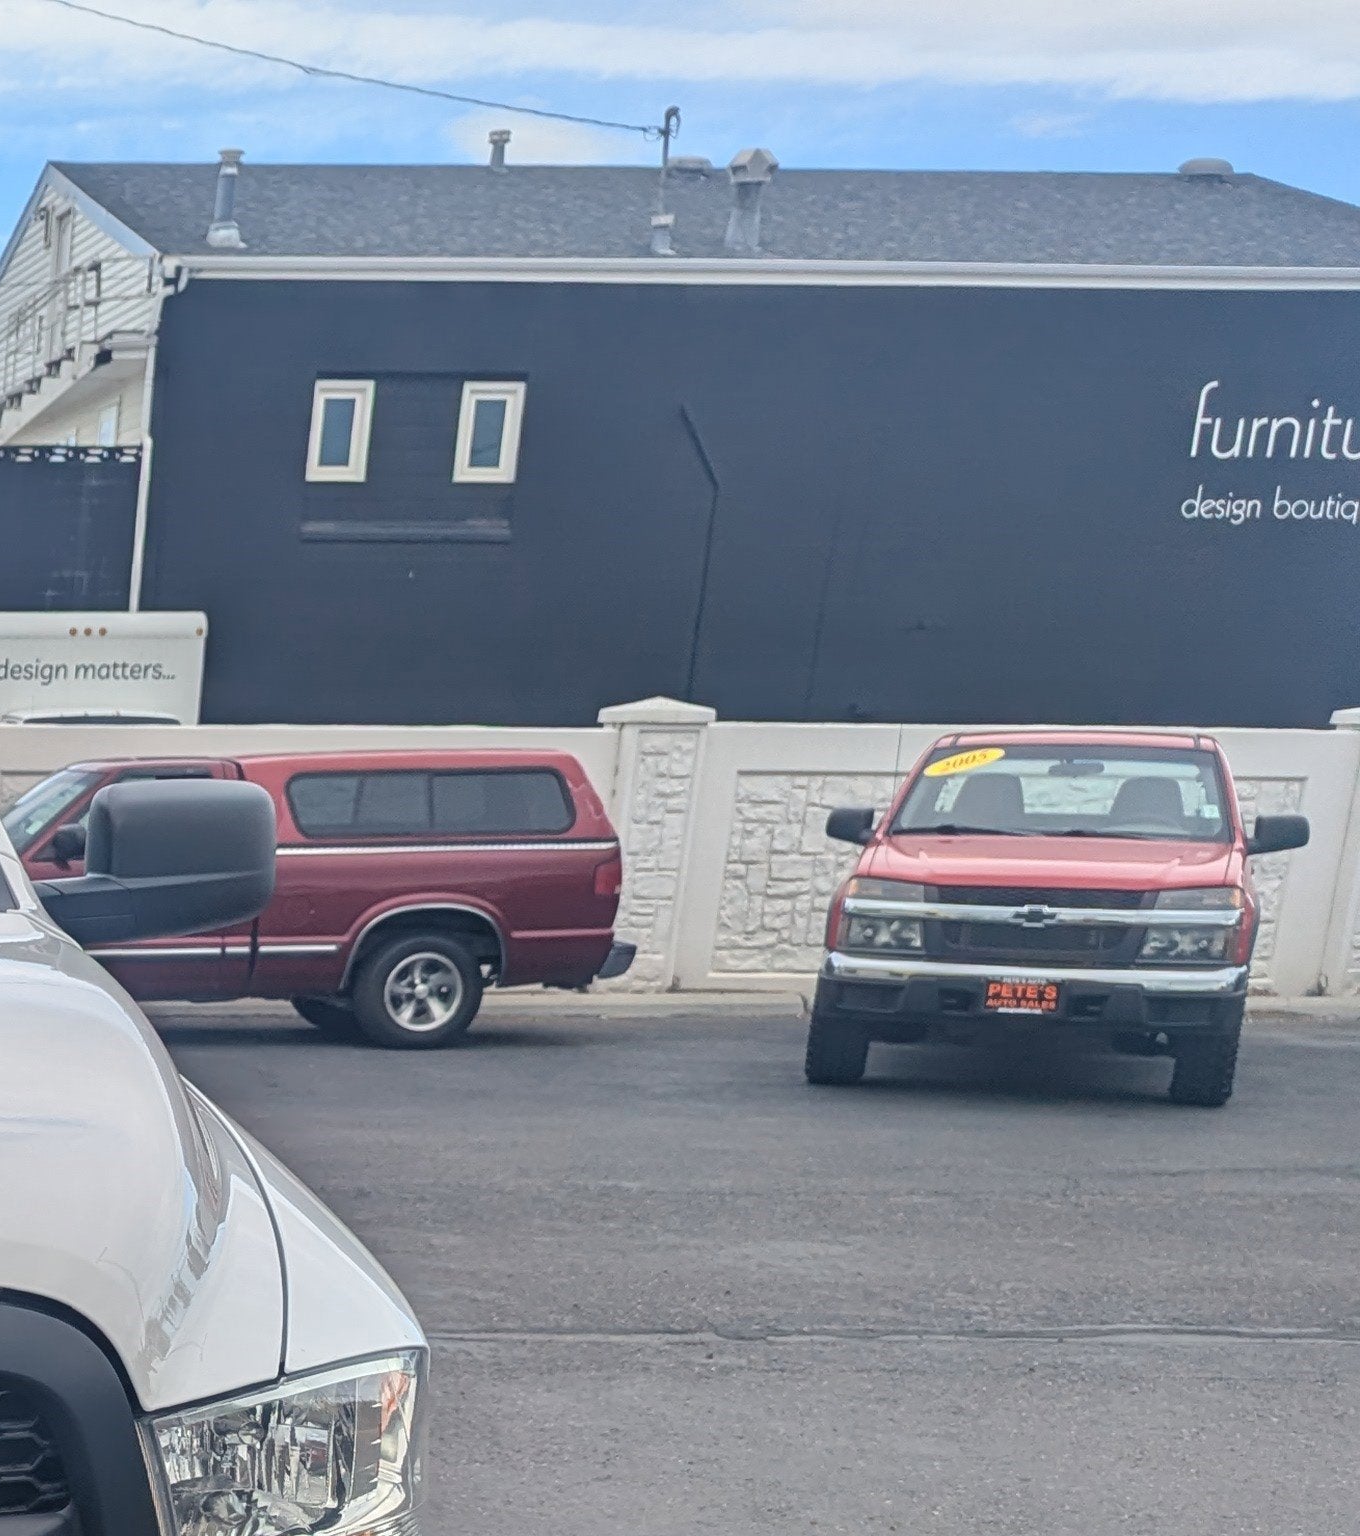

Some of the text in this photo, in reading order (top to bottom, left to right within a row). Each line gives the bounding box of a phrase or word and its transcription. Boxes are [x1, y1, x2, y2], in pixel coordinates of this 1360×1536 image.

[1181, 484, 1360, 525] design boutiq
[74, 661, 176, 681] matters...
[987, 983, 1057, 1000] PETE'S
